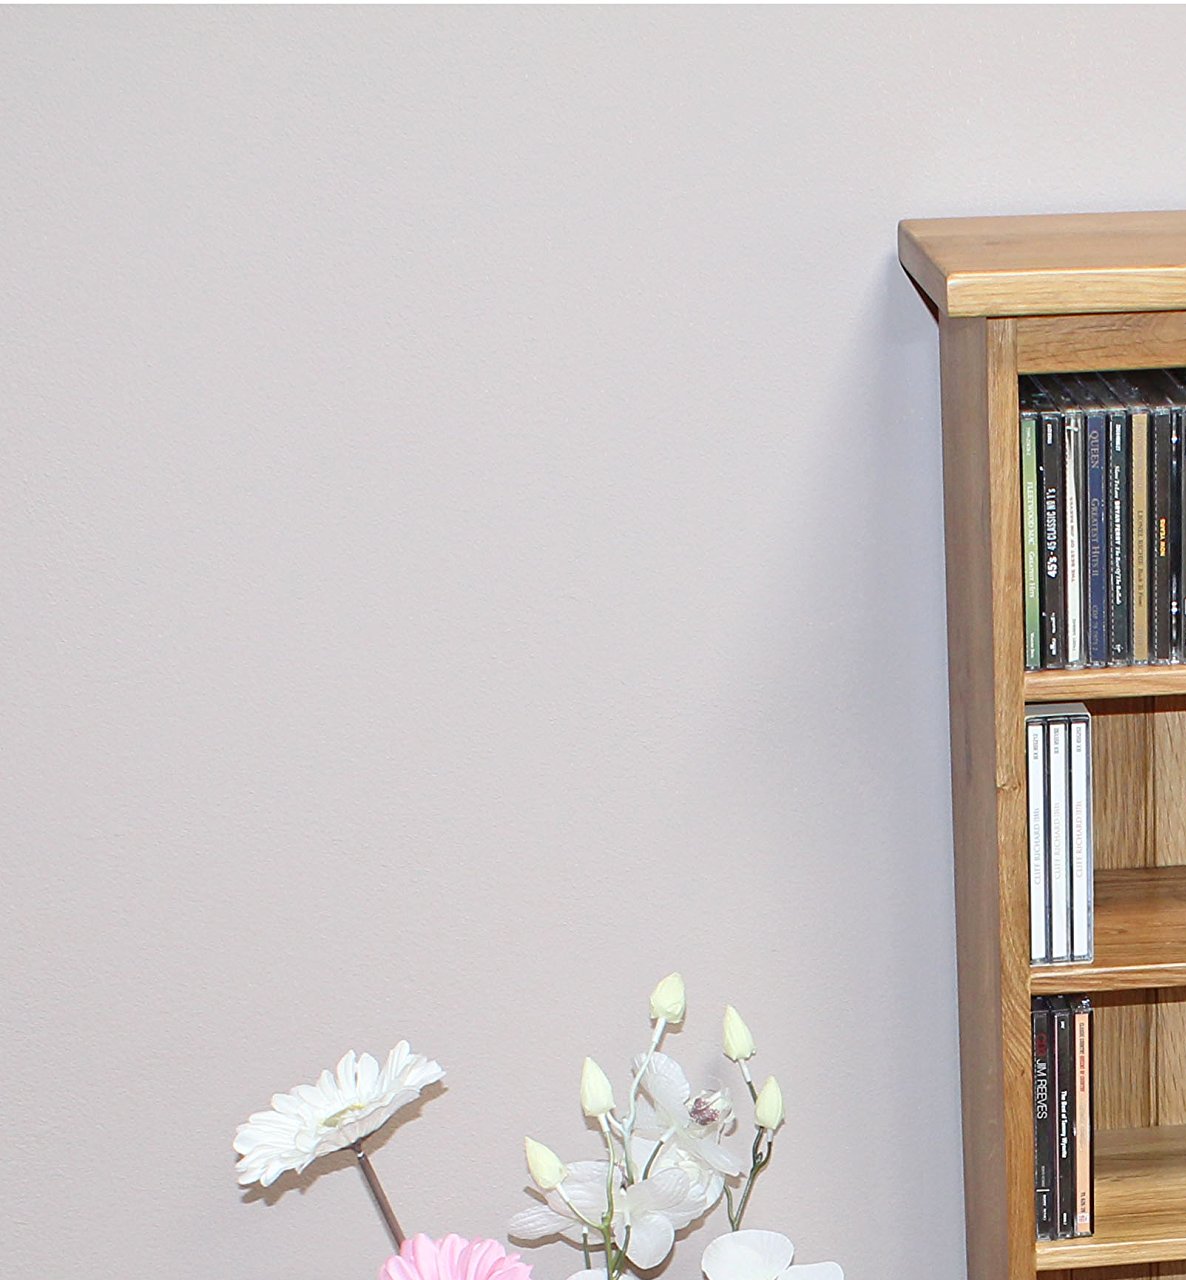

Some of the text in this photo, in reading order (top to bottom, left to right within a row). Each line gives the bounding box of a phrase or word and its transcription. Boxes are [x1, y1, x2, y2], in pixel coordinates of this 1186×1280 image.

[1089, 430, 1100, 469] QUEEN
[1027, 481, 1035, 528] FLEETWOOD
[1047, 511, 1057, 541] CLASSIC
[1047, 542, 1057, 552] 45
[1047, 556, 1057, 578] 45's
[1033, 823, 1041, 861] RICHARD
[1075, 815, 1083, 855] RICHARD
[1033, 862, 1041, 885] CLIFF
[1075, 856, 1083, 879] CLIFF
[1036, 1058, 1047, 1076] JIM
[1036, 1078, 1048, 1119] REEVES
